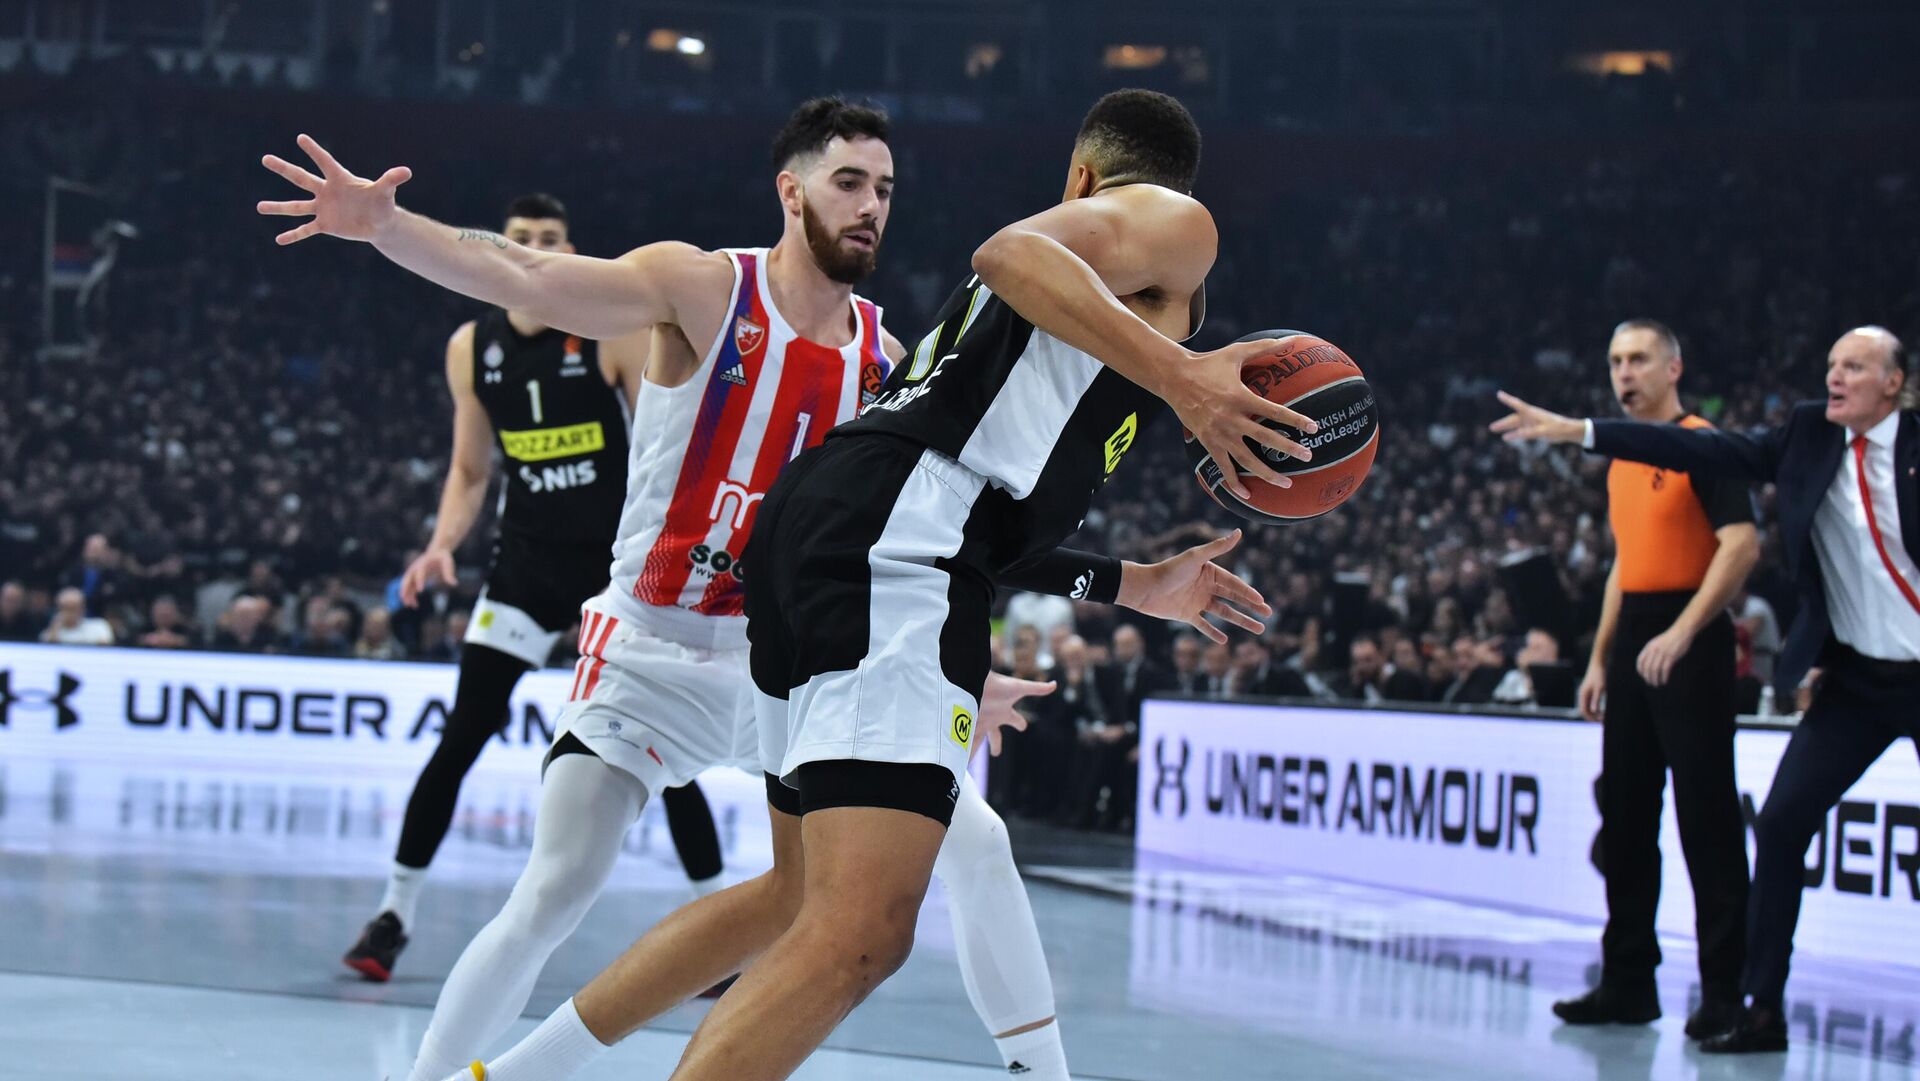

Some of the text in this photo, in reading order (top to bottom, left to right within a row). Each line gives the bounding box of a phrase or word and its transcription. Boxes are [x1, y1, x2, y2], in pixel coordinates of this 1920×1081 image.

[720, 373, 747, 386] adidas
[1247, 345, 1356, 397] PALDING
[526, 380, 542, 423] 1
[509, 429, 596, 453] OZZART
[790, 412, 811, 462] 1
[1299, 415, 1370, 450] EuroLeague
[542, 459, 597, 492] NIS
[125, 683, 391, 739] UNDER
[1205, 748, 1540, 856] UNDER ARMOUR
